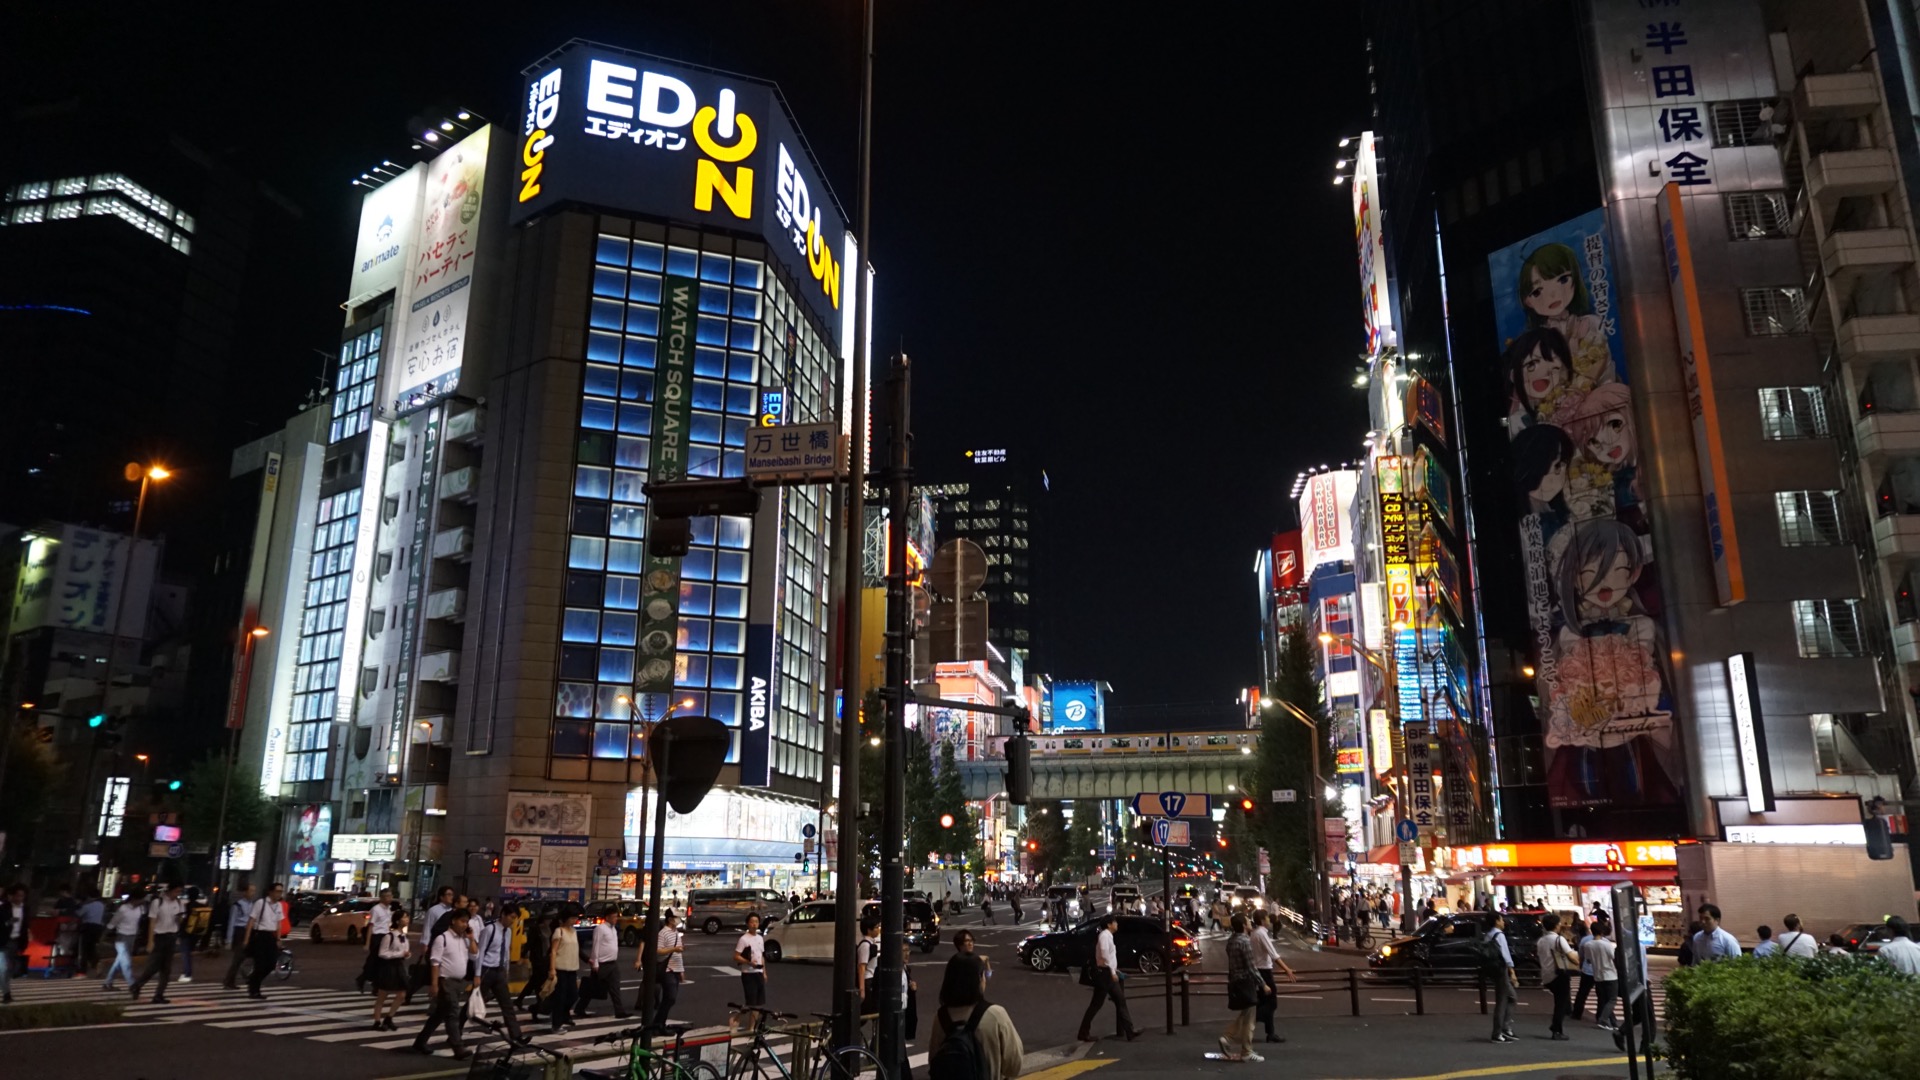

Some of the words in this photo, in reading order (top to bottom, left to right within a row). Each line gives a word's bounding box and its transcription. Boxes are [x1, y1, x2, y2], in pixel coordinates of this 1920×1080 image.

[1637, 0, 1711, 186] 半田保全
[519, 68, 562, 202] EDION
[584, 116, 687, 151] エディオン
[587, 59, 757, 219] EDION
[777, 142, 839, 310] EDION
[420, 229, 469, 264] パセラで
[415, 250, 474, 290] パーティー
[667, 286, 689, 366] WATCH
[1683, 350, 1702, 420] 2号館
[661, 369, 682, 463] SQUARE
[762, 392, 782, 427] EDIO
[753, 430, 829, 454] 万世橋
[750, 455, 801, 469] Manseibashi
[804, 453, 832, 467] Bridge
[410, 427, 437, 578] カプセルホテル
[1316, 483, 1326, 547] AKIHABARA
[1324, 477, 1334, 527] WELCOME
[1329, 531, 1337, 545] TO
[1382, 494, 1402, 502] ゲーム
[1384, 504, 1401, 512] CD
[1383, 514, 1404, 522] アイドル
[1384, 524, 1405, 533] アニメ
[1385, 535, 1405, 543] コミック
[1387, 545, 1405, 553] ホビー
[1391, 582, 1412, 624] DVD
[1523, 513, 1559, 691] 秋葉原泊地にようこそ。
[749, 676, 767, 732] AKIBA
[1408, 728, 1427, 740] 8F
[1583, 717, 1662, 737] Arcade
[1165, 795, 1182, 812] 17
[1410, 744, 1433, 827] (株)半田保全
[1159, 823, 1168, 840] 17
